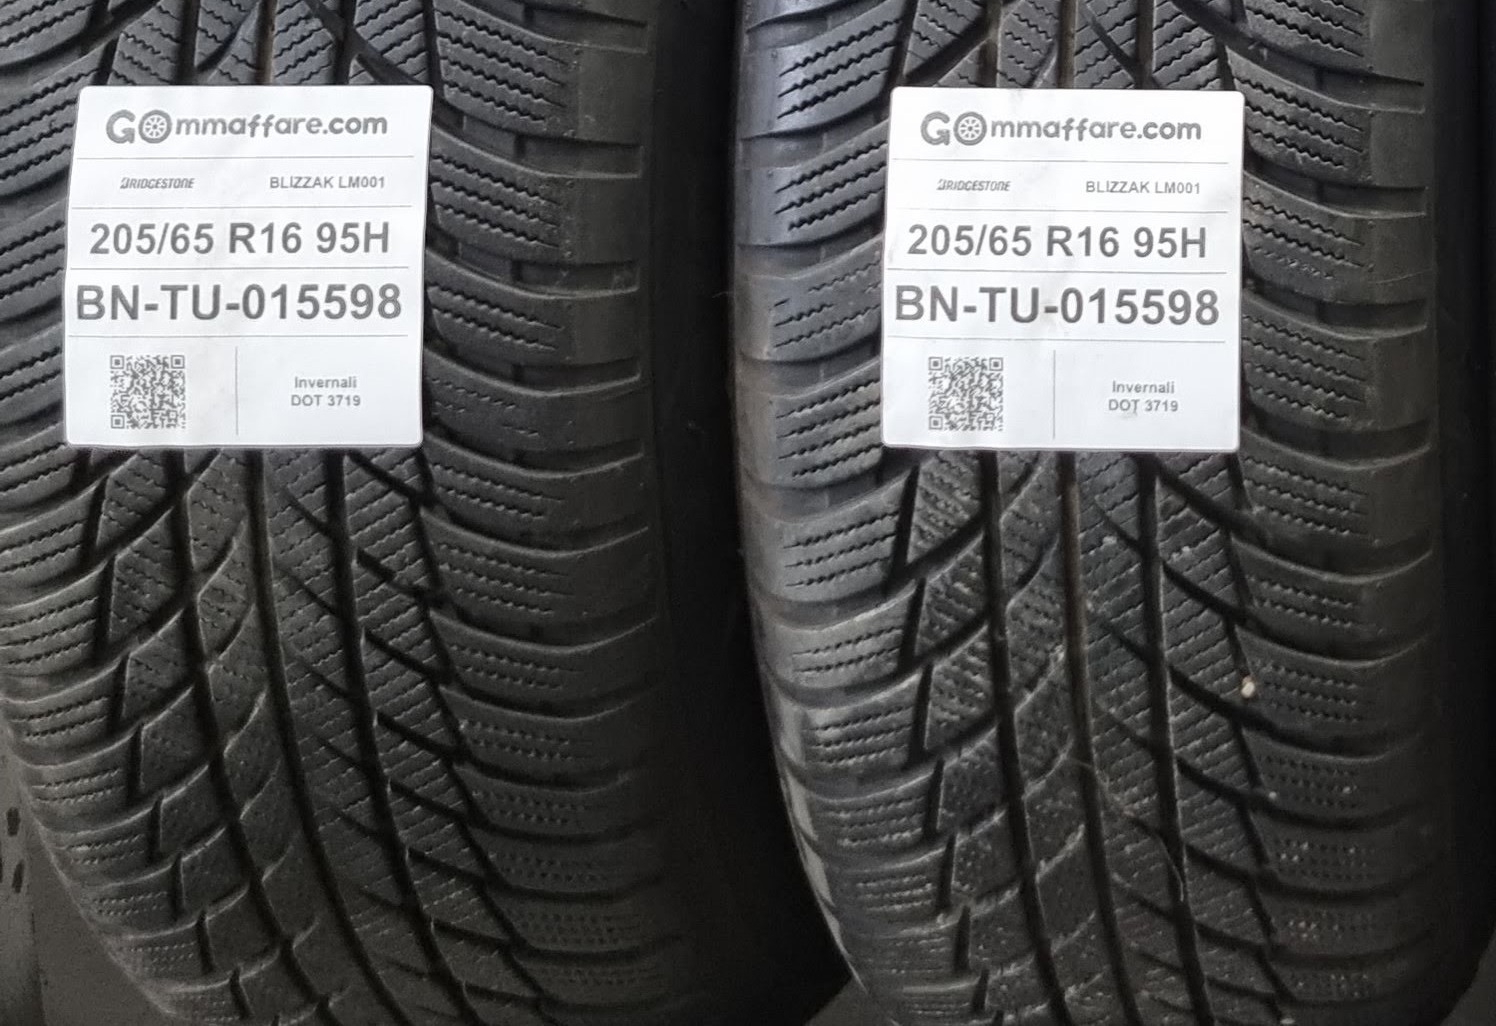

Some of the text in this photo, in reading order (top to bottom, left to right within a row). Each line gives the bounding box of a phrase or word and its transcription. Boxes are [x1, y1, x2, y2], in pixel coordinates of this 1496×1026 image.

[120, 177, 194, 189] BRIDGESTONE
[270, 176, 384, 188] BLIZZAK LM001
[937, 179, 1010, 191] BRIDGESTONE
[1086, 181, 1199, 194] BLIZZAK LM001
[90, 222, 388, 254] 205/65 R16 95H
[908, 224, 1205, 258] 205/65 R16 95H
[77, 284, 401, 320] BN-TU-015598
[896, 285, 1219, 325] BN-TU-015598
[295, 376, 356, 388] Invernali
[1113, 381, 1174, 393] Invernali
[291, 395, 360, 406] DOT 3719
[1109, 399, 1178, 414] DOT 3719
